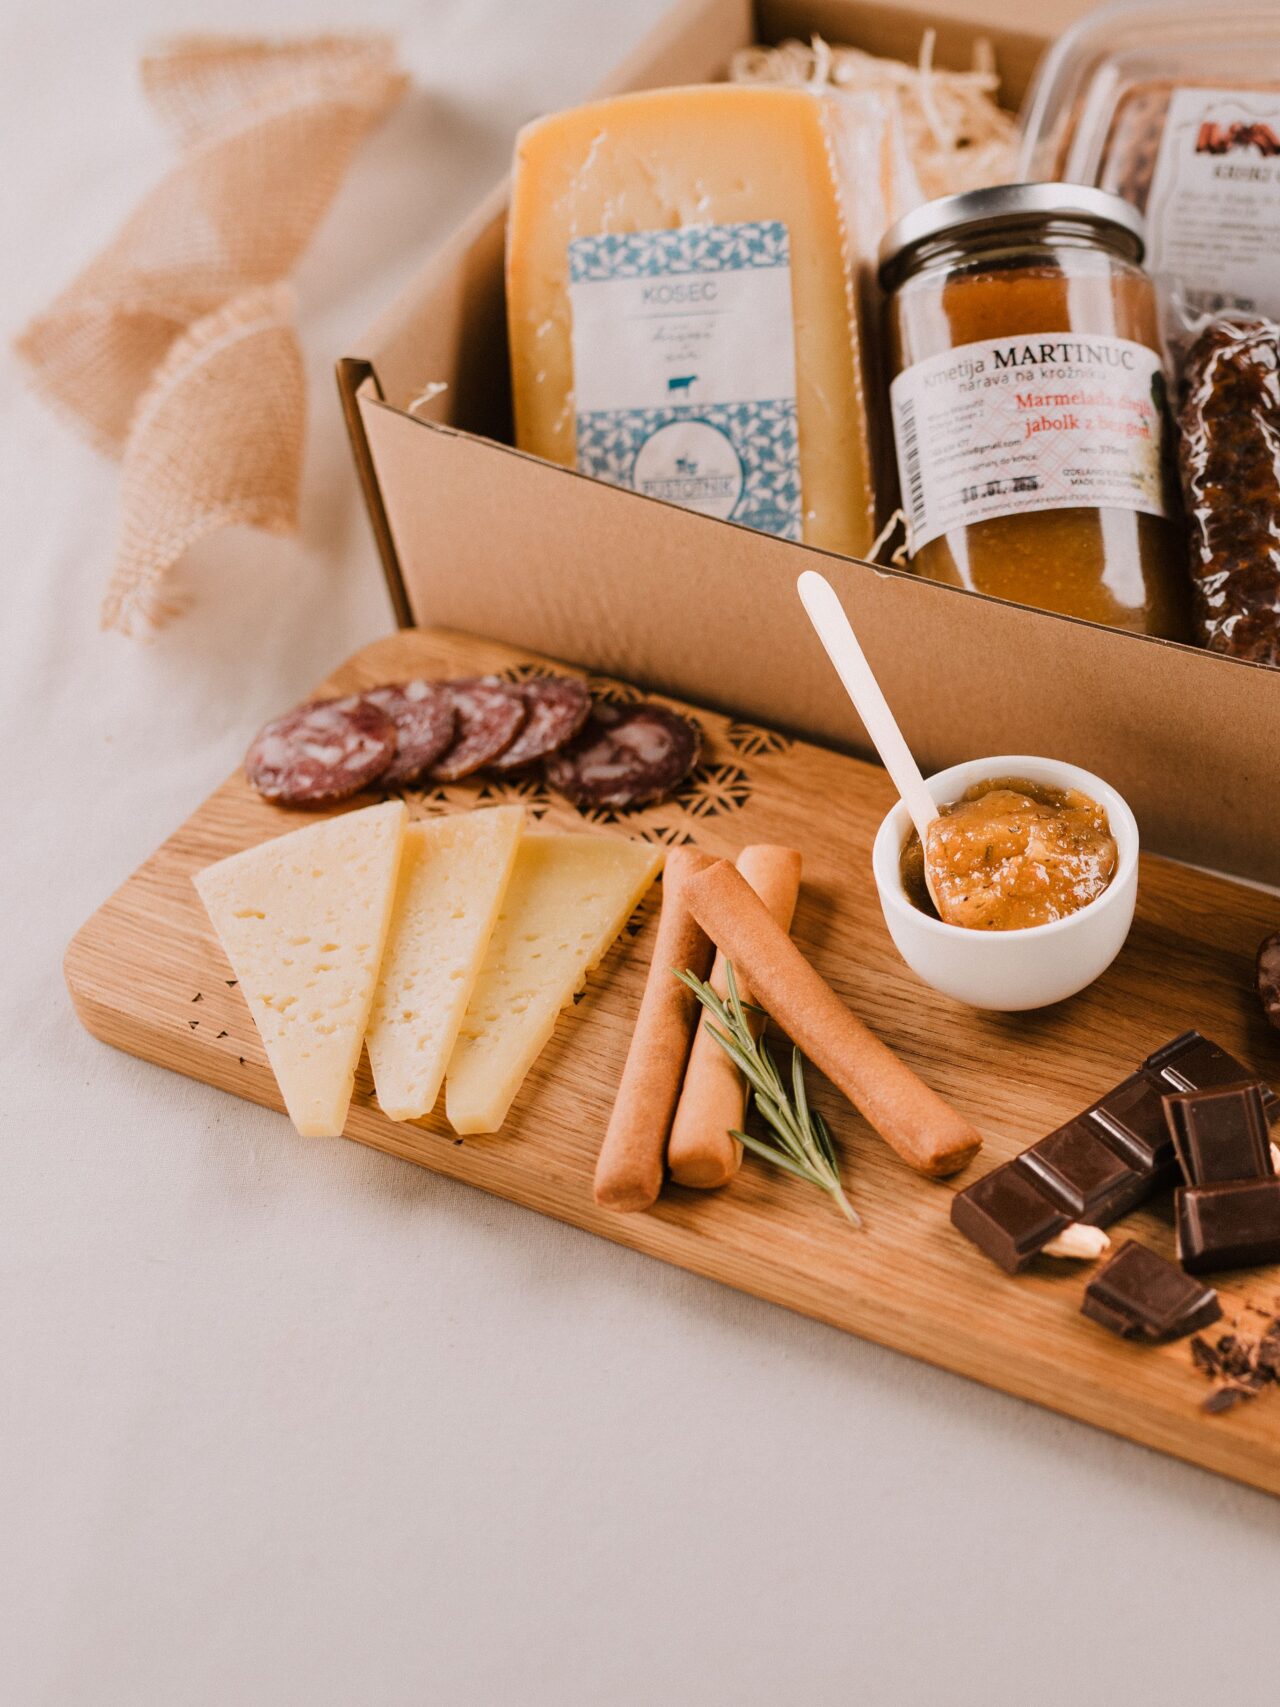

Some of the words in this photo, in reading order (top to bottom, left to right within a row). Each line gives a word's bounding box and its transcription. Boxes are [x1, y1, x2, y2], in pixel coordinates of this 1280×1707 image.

[642, 281, 719, 304] KOSEC
[993, 343, 1135, 371] MARTINUC
[958, 371, 1010, 394] narava
[1015, 371, 1035, 382] na
[1025, 414, 1080, 439] jabolk
